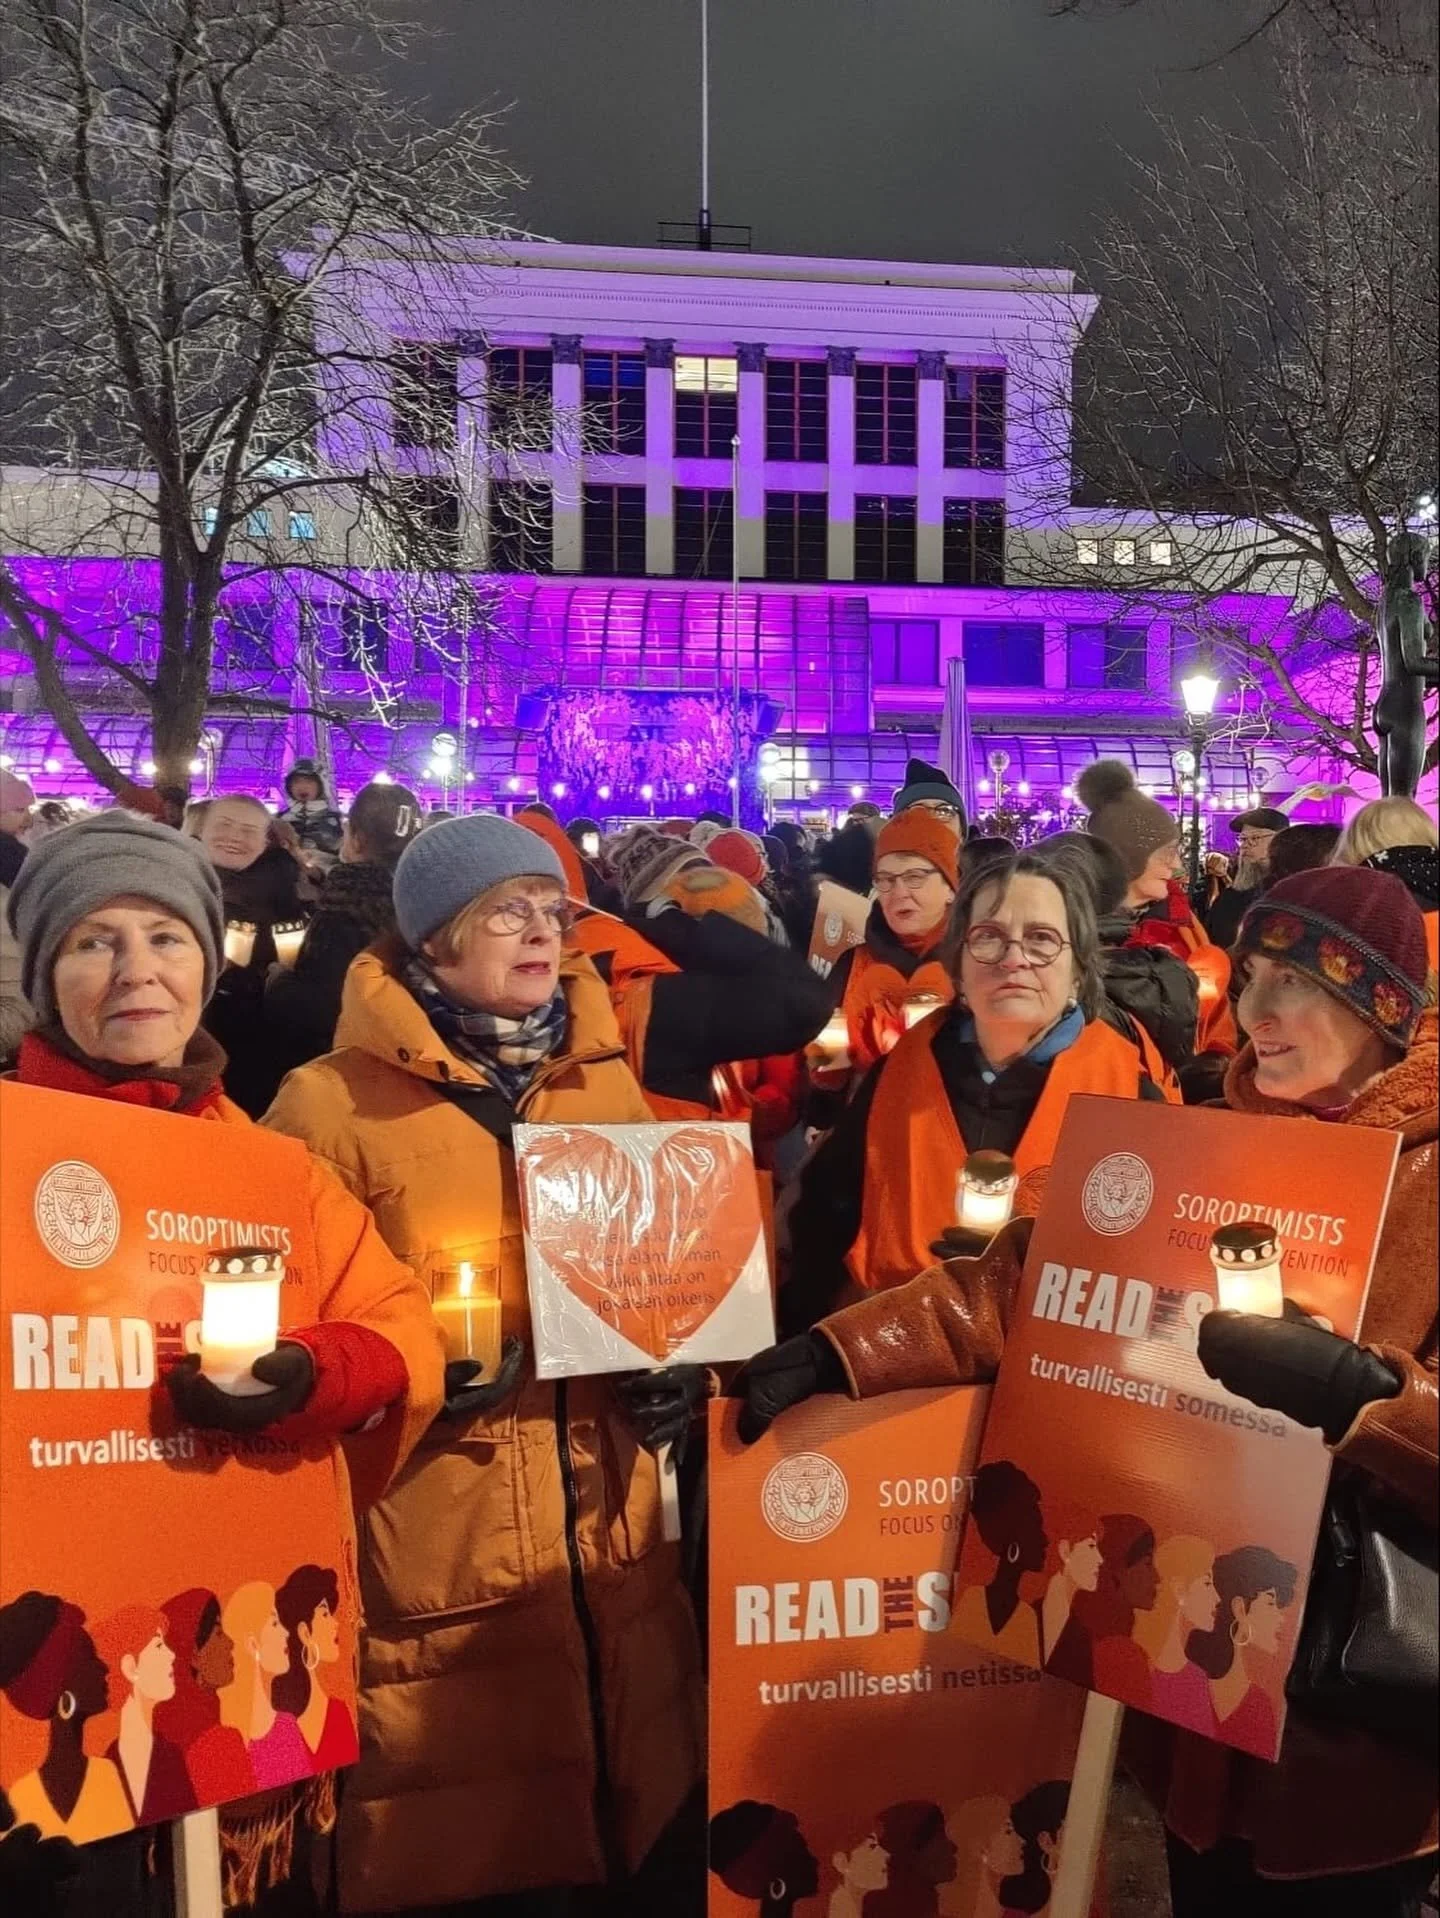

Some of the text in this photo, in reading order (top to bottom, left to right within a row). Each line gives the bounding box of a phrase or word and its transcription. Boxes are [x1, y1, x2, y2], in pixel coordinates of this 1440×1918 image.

[146, 1209, 292, 1255] SOROPTIMISTS
[1168, 1229, 1210, 1253] FOCU
[1174, 1193, 1346, 1245] SOROPTIMISTS
[149, 1251, 196, 1275] FOCUS
[1032, 1262, 1154, 1339] READ
[11, 1313, 155, 1390] READ
[1030, 1353, 1287, 1438] turvallisesti somessa
[30, 1427, 196, 1468] turvallisesti
[880, 1514, 935, 1536] FOCUS
[735, 1577, 879, 1645] READ
[884, 1575, 914, 1633] THE
[759, 1665, 932, 1704] turvallisesti
